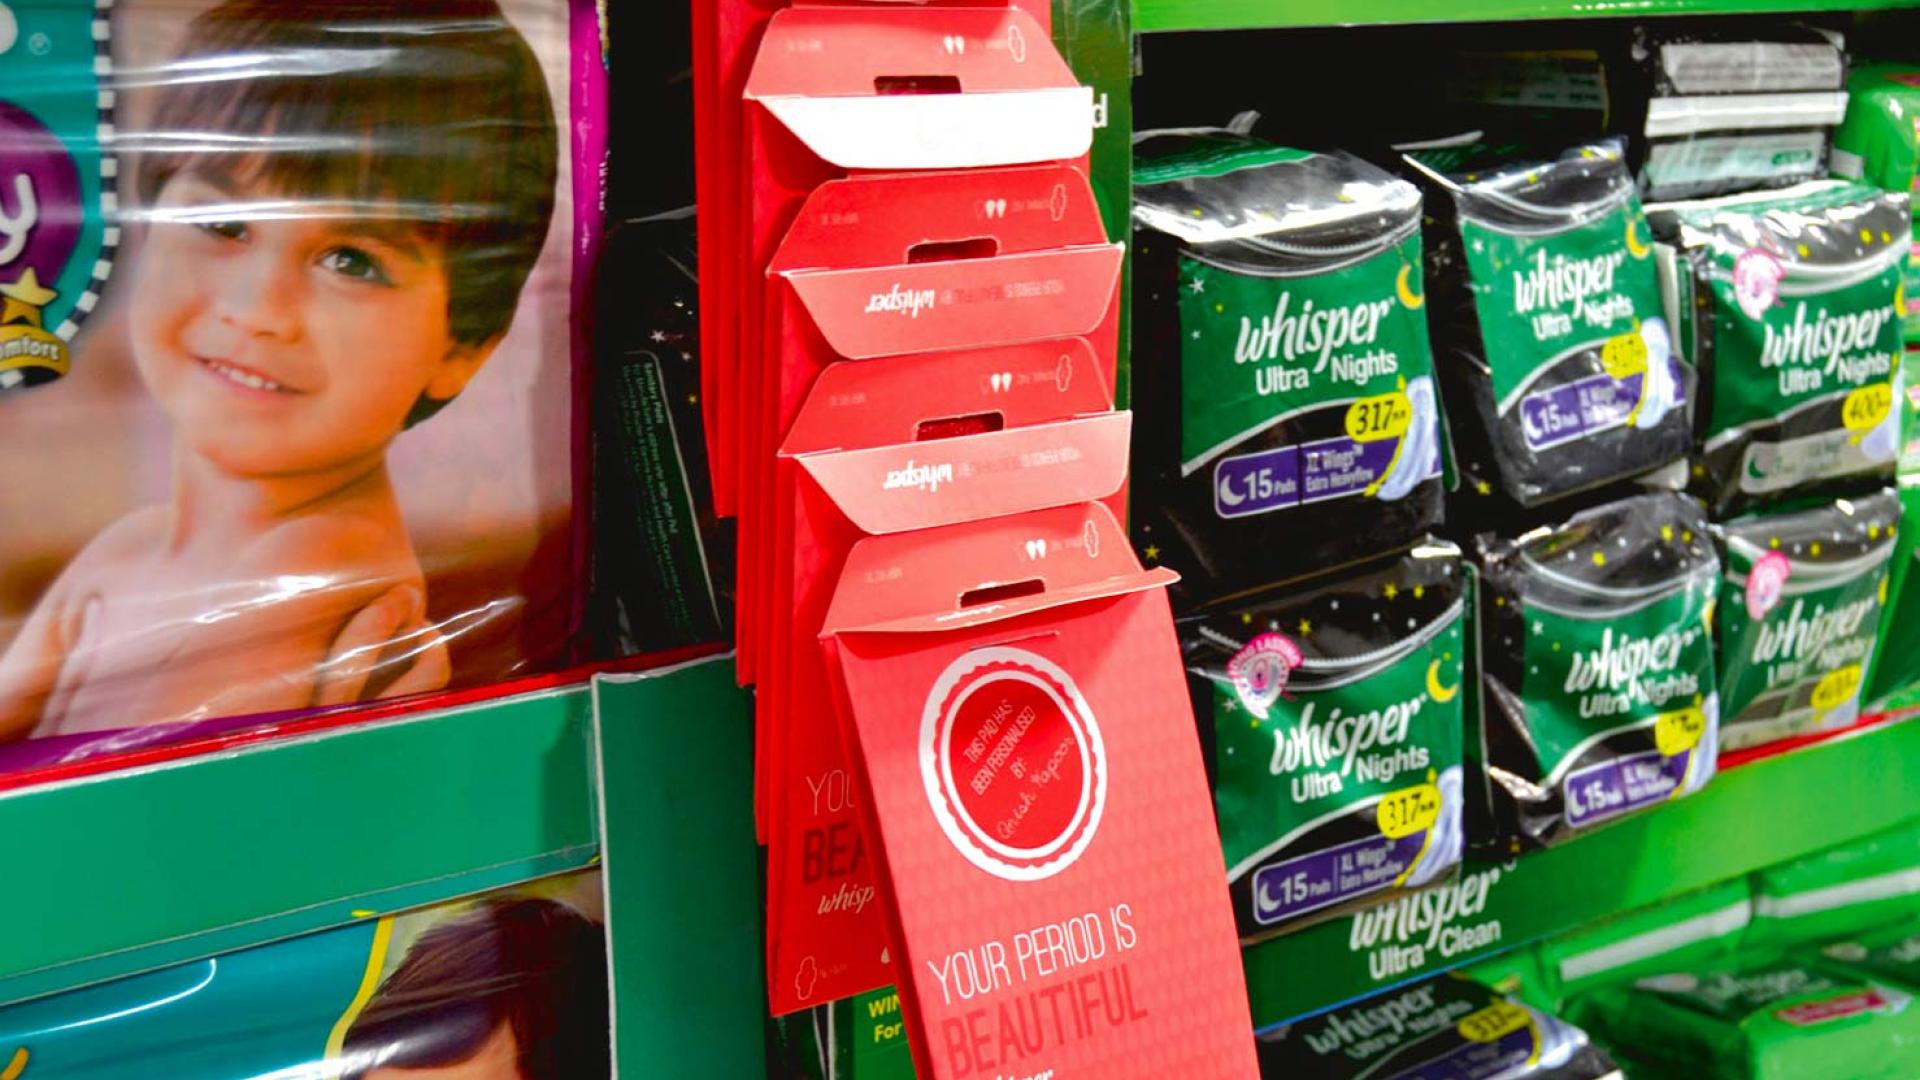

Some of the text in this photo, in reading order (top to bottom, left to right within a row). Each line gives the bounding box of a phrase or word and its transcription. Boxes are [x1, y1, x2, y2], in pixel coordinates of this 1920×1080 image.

[1513, 247, 1622, 318] whisper
[1234, 291, 1391, 373] whisper
[1532, 313, 1572, 340] Ultra
[1760, 301, 1890, 376] whisper
[1256, 349, 1398, 395] Ultra Nights
[1778, 351, 1891, 396] Ultra Nights
[1538, 404, 1561, 434] 15
[1243, 468, 1274, 501] 15
[1580, 694, 1630, 718] Ultra
[1270, 701, 1420, 776] whisper
[1291, 745, 1429, 802] Ultra Nights
[1584, 780, 1606, 811] 15
[1280, 872, 1309, 904] 15
[927, 903, 1137, 1005] YOUR PERIOD IS
[1369, 919, 1501, 980] Ultra Clean
[941, 963, 1148, 1079] BEAUTIFUL
